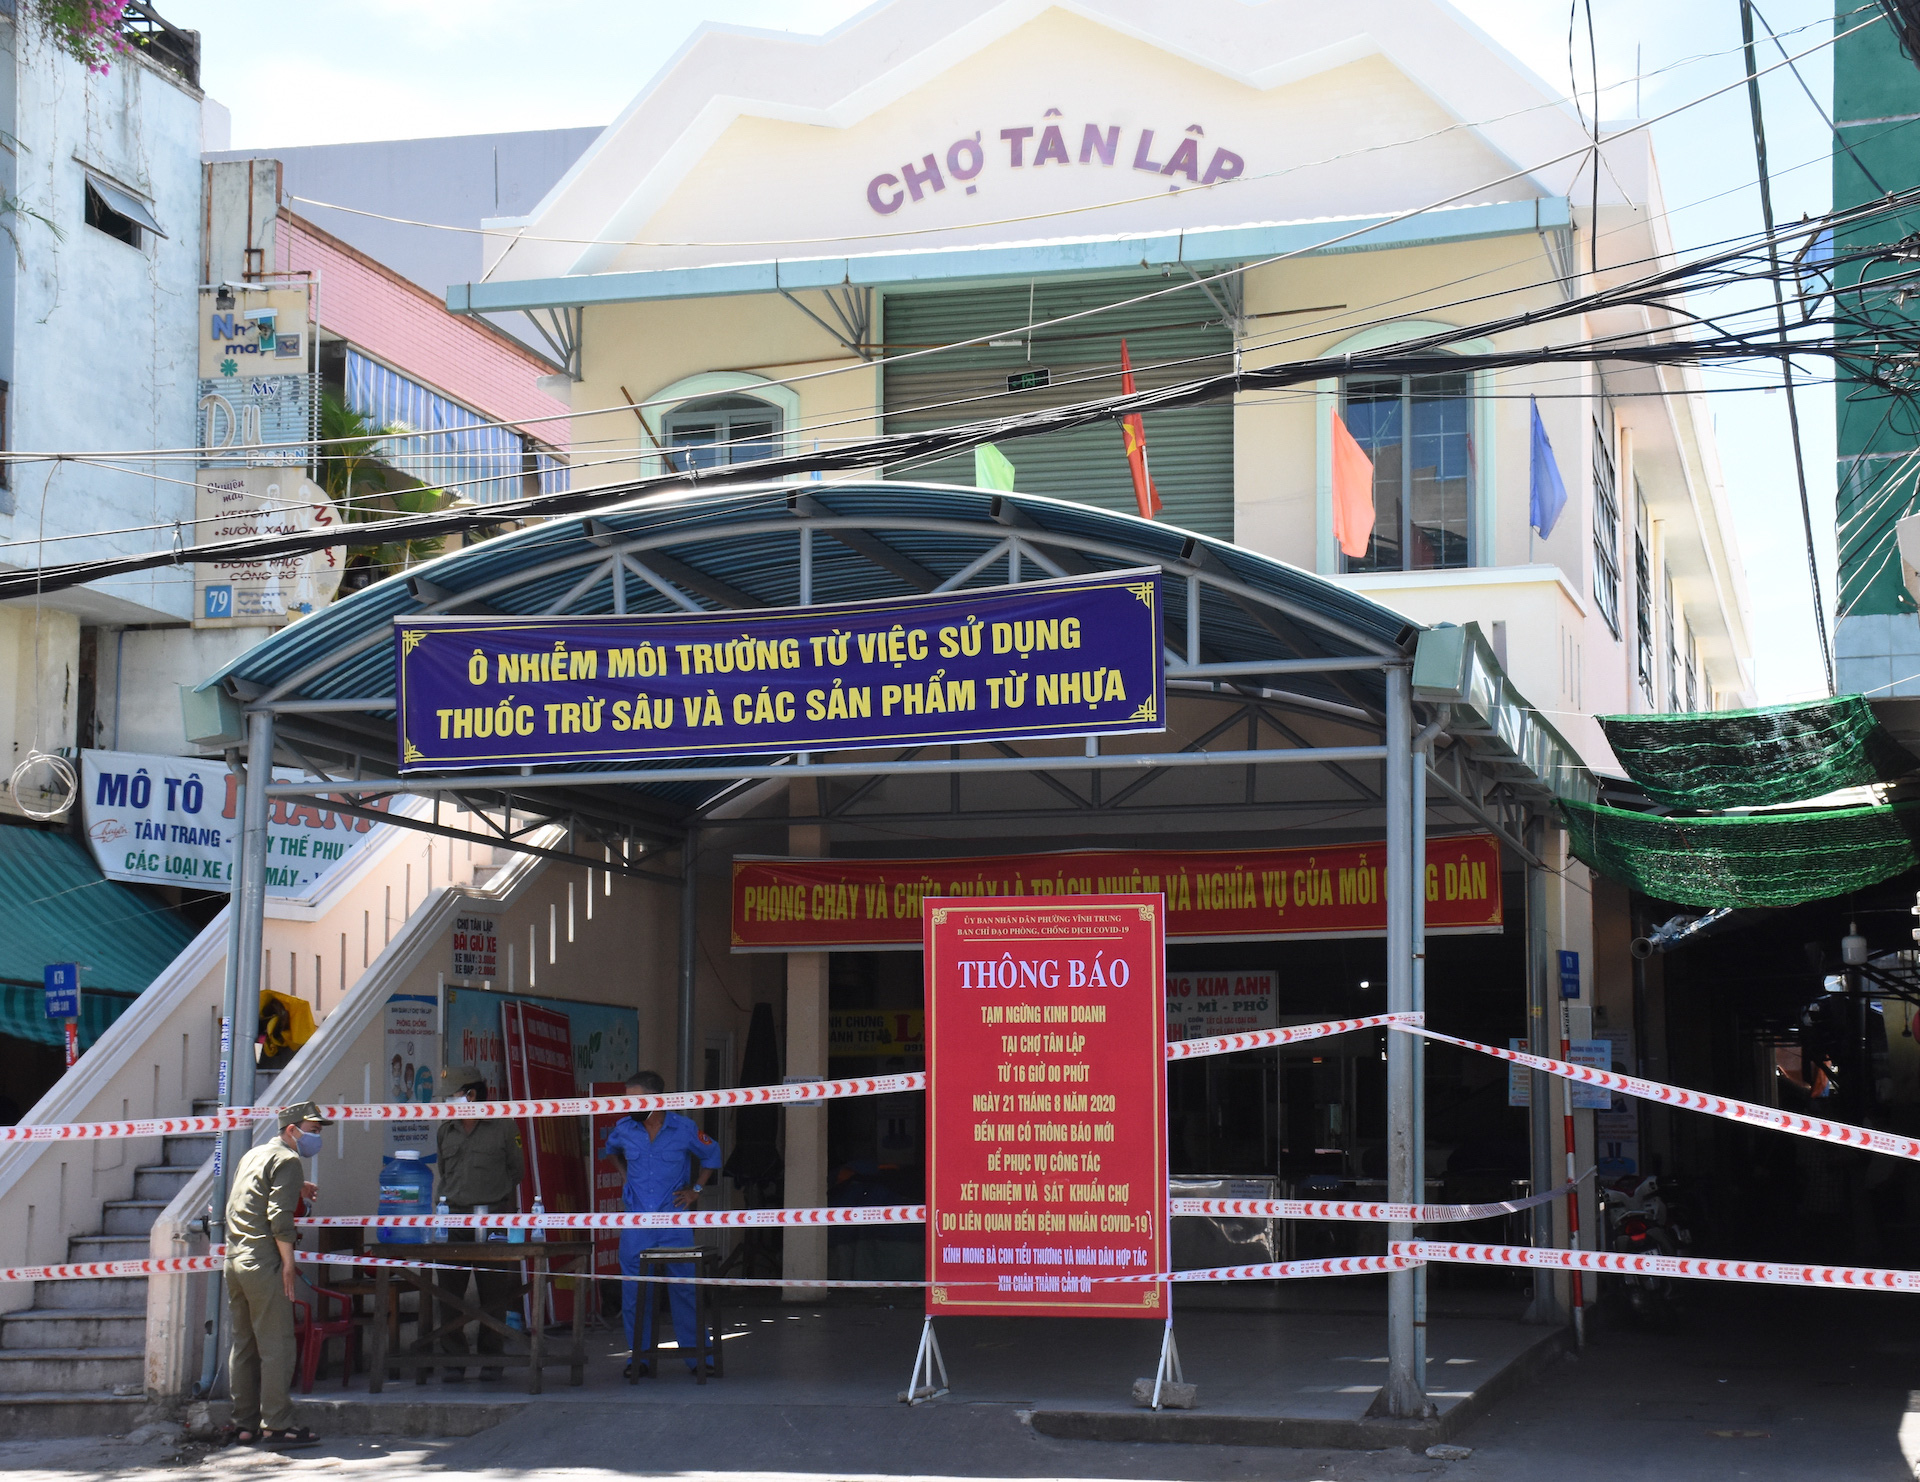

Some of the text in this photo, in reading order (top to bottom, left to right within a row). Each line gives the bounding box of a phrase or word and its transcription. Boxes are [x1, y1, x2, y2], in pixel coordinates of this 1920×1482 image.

[866, 107, 1245, 216] CHỢ TÂN LẬP
[209, 590, 228, 613] 79
[468, 615, 1081, 686] Ô NHIỄM MÔI TRƯỜNG TỪ VIỆC SỬ DỤNG
[436, 666, 1127, 739] THUỐC TRỪ SÂU VÀ CÁC SẢN PHẨM TỪ NHỰA
[96, 767, 152, 809] MÔ
[164, 772, 204, 815] TÔ
[135, 818, 167, 842] TÂN
[171, 824, 221, 848] TRANG
[280, 833, 310, 858] THẾ
[125, 849, 160, 872] CÁC
[165, 855, 198, 880] LOẠI
[202, 859, 223, 880] XE
[744, 876, 806, 922] PHÒNG
[811, 876, 860, 921] CHÁY
[864, 875, 889, 919] VÀ
[1165, 866, 1191, 911] VÀ
[1197, 865, 1257, 911] NGHĨA
[1261, 870, 1287, 916] VỤ
[1293, 857, 1334, 907] CỦA
[1338, 853, 1378, 905] MỖI
[1444, 853, 1487, 901] DÂN
[957, 928, 974, 936] BAN
[991, 927, 1009, 937] ĐẠO
[1041, 924, 1070, 935] CHỐNG
[1071, 926, 1092, 936] DỊCH
[1093, 925, 1130, 934] COVID-19
[977, 917, 994, 925] BAN
[995, 916, 1018, 924] NHÂN
[1019, 915, 1037, 924] DÂN
[1038, 914, 1071, 924] PHƯỜNG
[1072, 914, 1093, 923] VĨNH
[1094, 915, 1122, 923] TRUNG
[486, 936, 497, 953] XE
[957, 950, 1130, 989] THÔNG BÁO
[1197, 977, 1230, 997] KIM
[1233, 975, 1271, 996] ANH
[981, 1002, 1106, 1027] TẠM NGỪNG KINH DOANH
[1197, 999, 1218, 1013] MÌ
[1232, 996, 1269, 1012] PHỞ
[1001, 1031, 1086, 1056] TẠI CHỢ TÂN LẬP
[998, 1061, 1090, 1083] TỪ 16 GIỜ 00 PHÚT
[972, 1091, 1116, 1112] NGÀY 21 THÁNG 8 NĂM 2020
[974, 1119, 1115, 1142] ĐẾN KHI CÓ THÔNG BÁO MỚI
[987, 1146, 1101, 1175] ĐỂ PHỤC VỤ CÔNG TÁC
[960, 1177, 1130, 1206] XÉT NGHIỆM VÀ SÁT KHUẨN CHỢ
[959, 1210, 982, 1231] LIÊN
[984, 1213, 1012, 1233] QUAN
[1015, 1208, 1036, 1232] ĐẾN
[1038, 1211, 1066, 1235] BỆNH
[1068, 1211, 1098, 1232] NHÂN
[943, 1244, 961, 1264] KÍNH
[962, 1247, 985, 1264] MONG
[986, 1244, 997, 1264] BÀ
[998, 1248, 1014, 1265] CON
[1015, 1242, 1032, 1265] TIỂU
[1064, 1245, 1074, 1265] VÀ
[1075, 1246, 1097, 1266] NHÂN
[1098, 1246, 1114, 1266] DÂN
[1115, 1248, 1131, 1269] HỢP
[1133, 1246, 1148, 1267] TÁC
[998, 1275, 1012, 1292] XIN
[1013, 1273, 1034, 1292] CHÂN
[1035, 1273, 1060, 1292] THÀNH
[1061, 1271, 1079, 1293] CẢM
